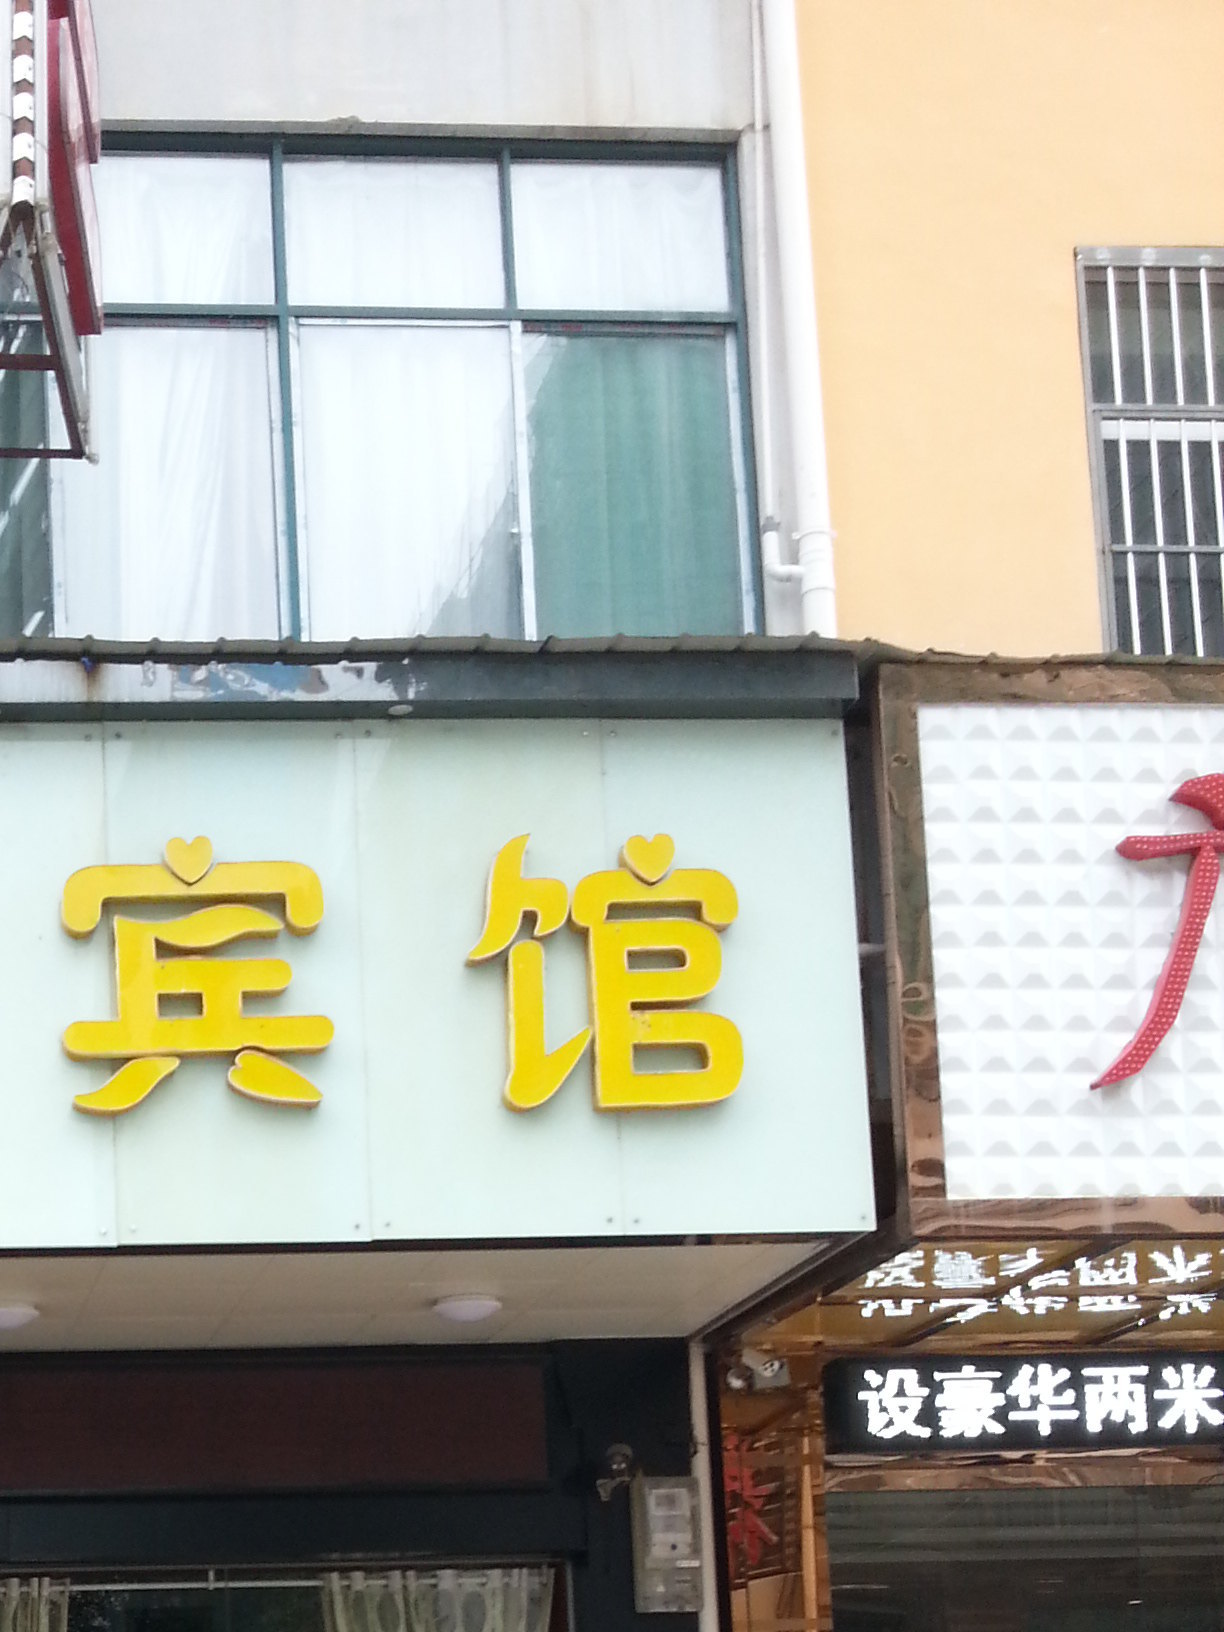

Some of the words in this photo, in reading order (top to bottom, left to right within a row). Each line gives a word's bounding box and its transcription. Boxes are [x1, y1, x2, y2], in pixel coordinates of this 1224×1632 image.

[857, 1363, 1224, 1438] 设豪华两米
